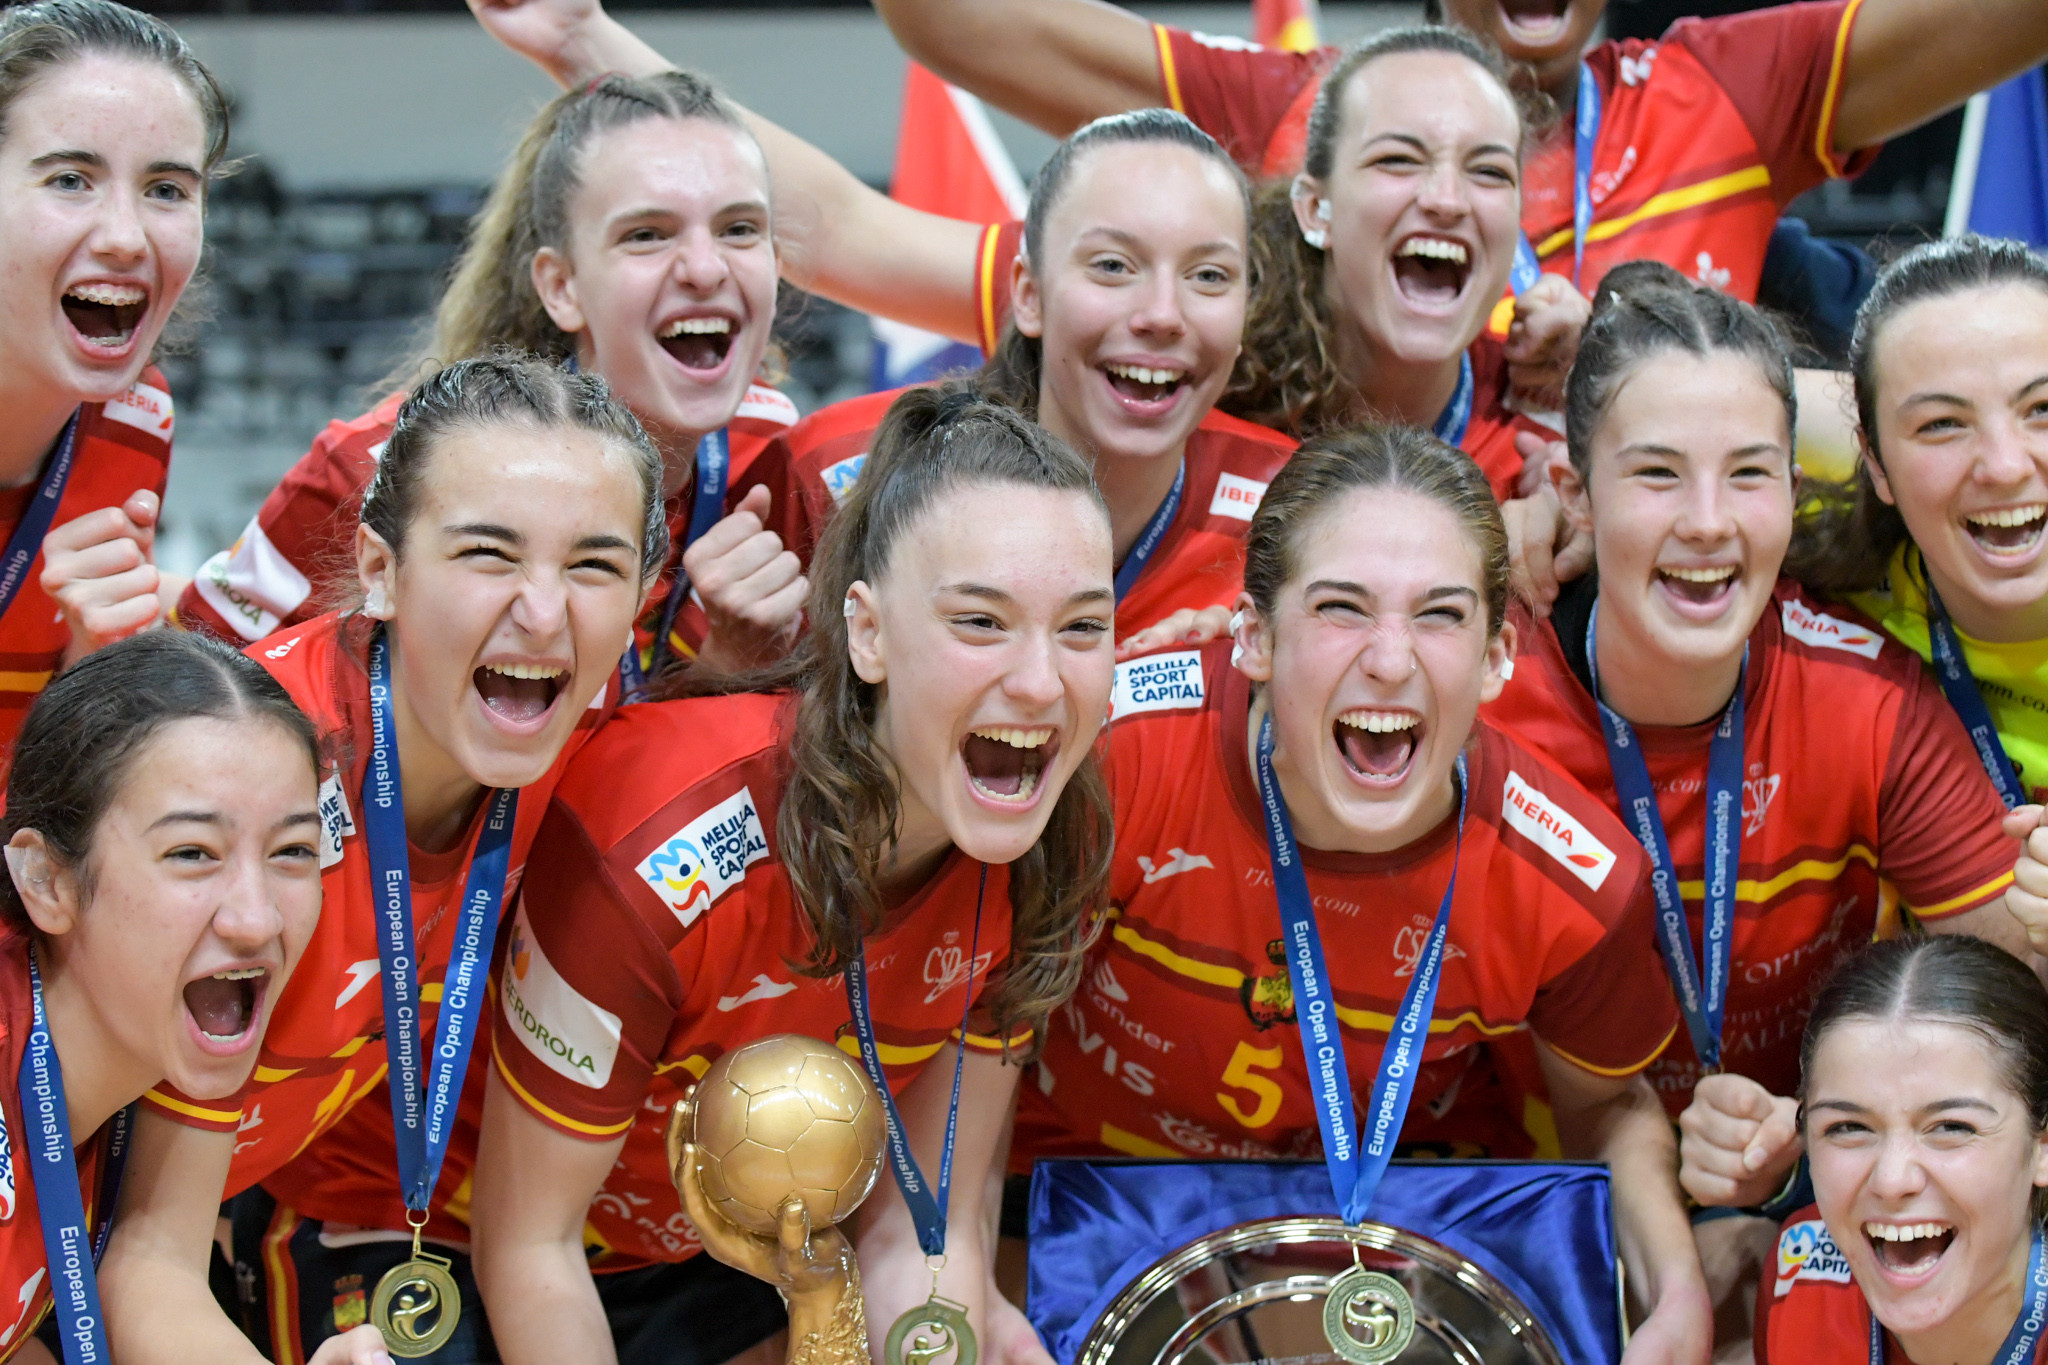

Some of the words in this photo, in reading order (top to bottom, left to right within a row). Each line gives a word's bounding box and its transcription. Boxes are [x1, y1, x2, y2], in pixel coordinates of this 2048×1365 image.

[1136, 495, 1176, 560] European
[1219, 485, 1263, 505] IBE
[0, 549, 28, 600] onship
[1128, 657, 1200, 677] MELILLA
[1130, 669, 1188, 689] SPORT
[1132, 683, 1205, 704] CAPITAL
[370, 685, 395, 808] Championship
[489, 787, 512, 831] Euro
[1261, 753, 1291, 867] Championship
[1506, 786, 1573, 847] IBERIA
[719, 835, 766, 880] CAPAL
[1711, 789, 1733, 898] Championship
[385, 869, 405, 953] European
[1710, 899, 1727, 941] Open
[391, 955, 410, 1002] Open
[449, 887, 492, 1010] Championship
[1708, 942, 1728, 1013] European
[440, 1012, 463, 1060] Open
[1092, 992, 1176, 1054] ander
[1293, 920, 1319, 998] European
[1306, 1000, 1329, 1044] Open
[1318, 1045, 1352, 1162] Championship
[1368, 1080, 1400, 1157] European
[1387, 1036, 1412, 1079] Open
[1401, 924, 1446, 1034] Championship
[30, 1030, 63, 1163] Championship
[397, 1005, 420, 1130] Championship
[850, 961, 867, 1038] European
[863, 1042, 880, 1084] Open
[876, 1087, 920, 1194] Championship
[1216, 1039, 1284, 1129] 5
[429, 1062, 454, 1145] European
[60, 1225, 87, 1313] European
[1802, 1257, 1852, 1275] APIT
[73, 1315, 97, 1365] Open
[2005, 1333, 2033, 1365] pean
[2023, 1290, 2048, 1332] Open
